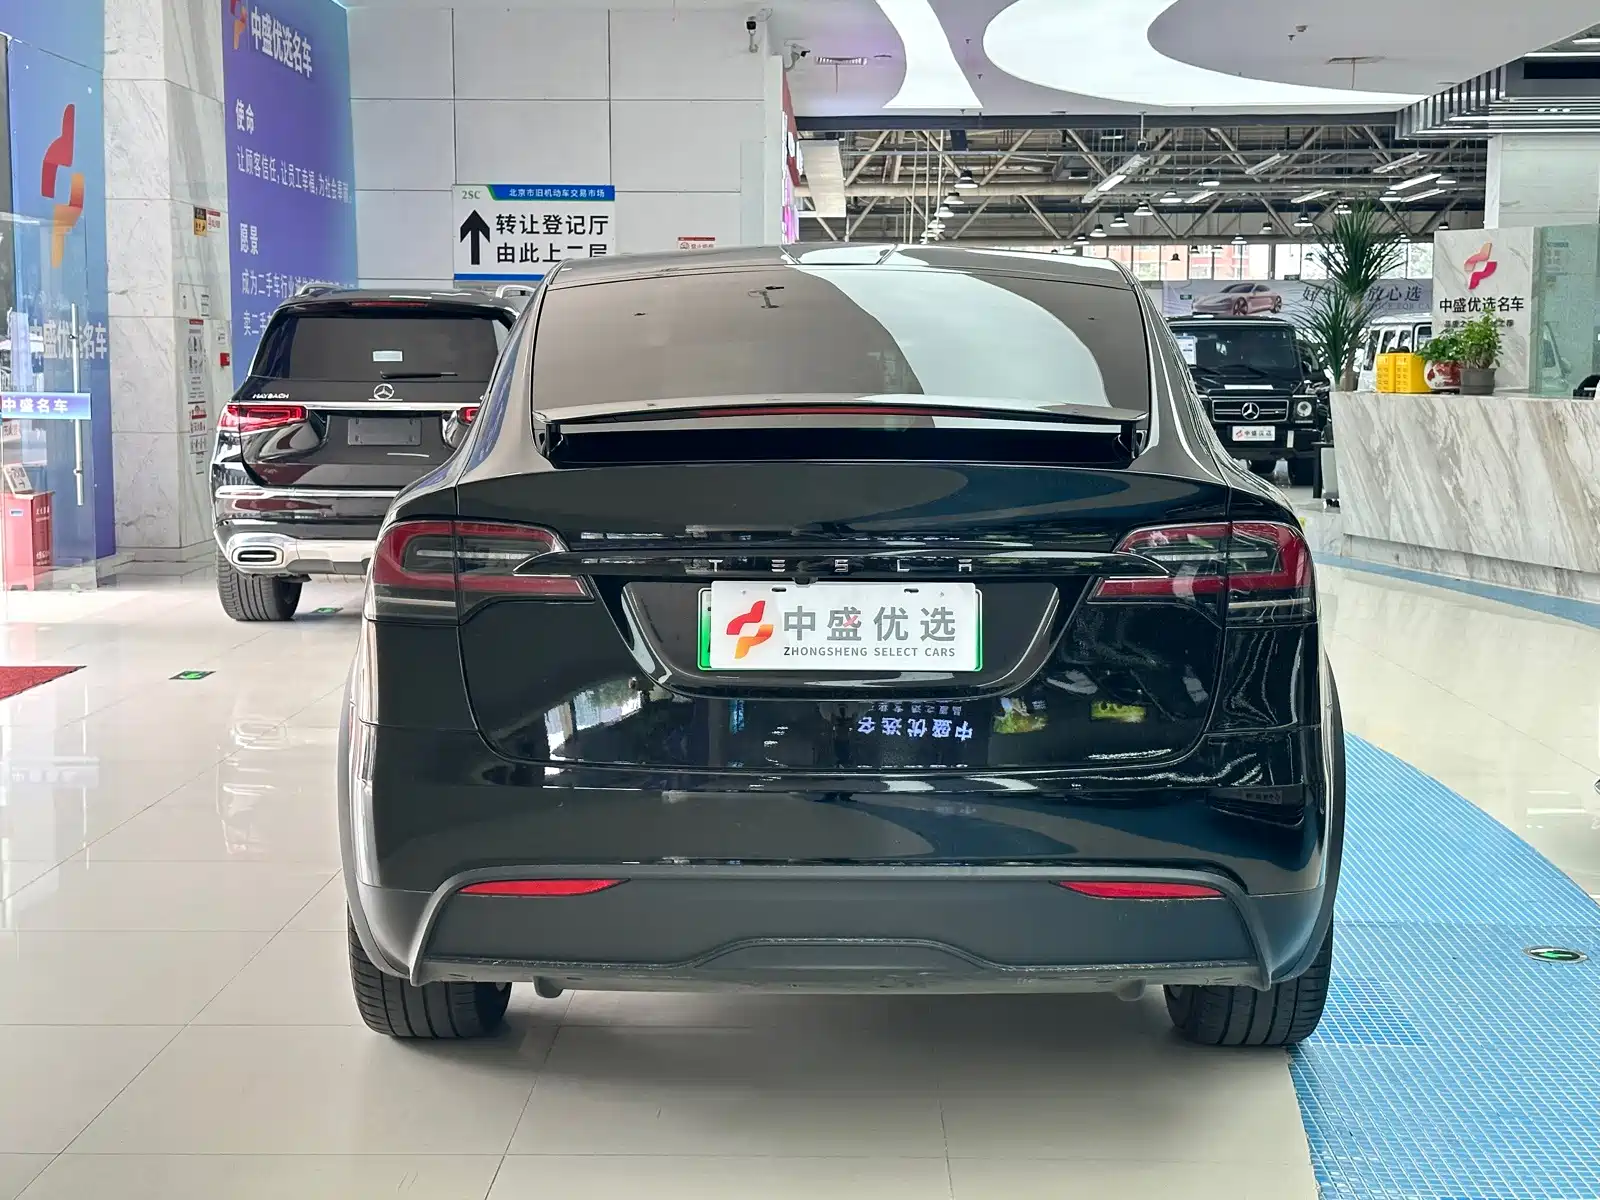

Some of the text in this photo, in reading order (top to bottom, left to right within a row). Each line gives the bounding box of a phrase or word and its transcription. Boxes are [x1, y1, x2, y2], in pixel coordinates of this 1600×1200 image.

[251, 5, 313, 78] 中盛优选名车
[236, 98, 255, 134] 使命
[461, 190, 480, 200] 2SC
[509, 188, 605, 198] 北京市旧机动车交易市场
[496, 214, 609, 236] 转让登记厅
[240, 222, 259, 255] 愿景
[1439, 296, 1524, 313] 中盛优选名车
[29, 319, 107, 360] 中盛优名车
[2, 396, 69, 414] 中盛名车
[708, 558, 973, 573] TESLA
[783, 605, 956, 642] 中盛优选
[783, 646, 956, 658] ZHONGSHENG SELECT CARS
